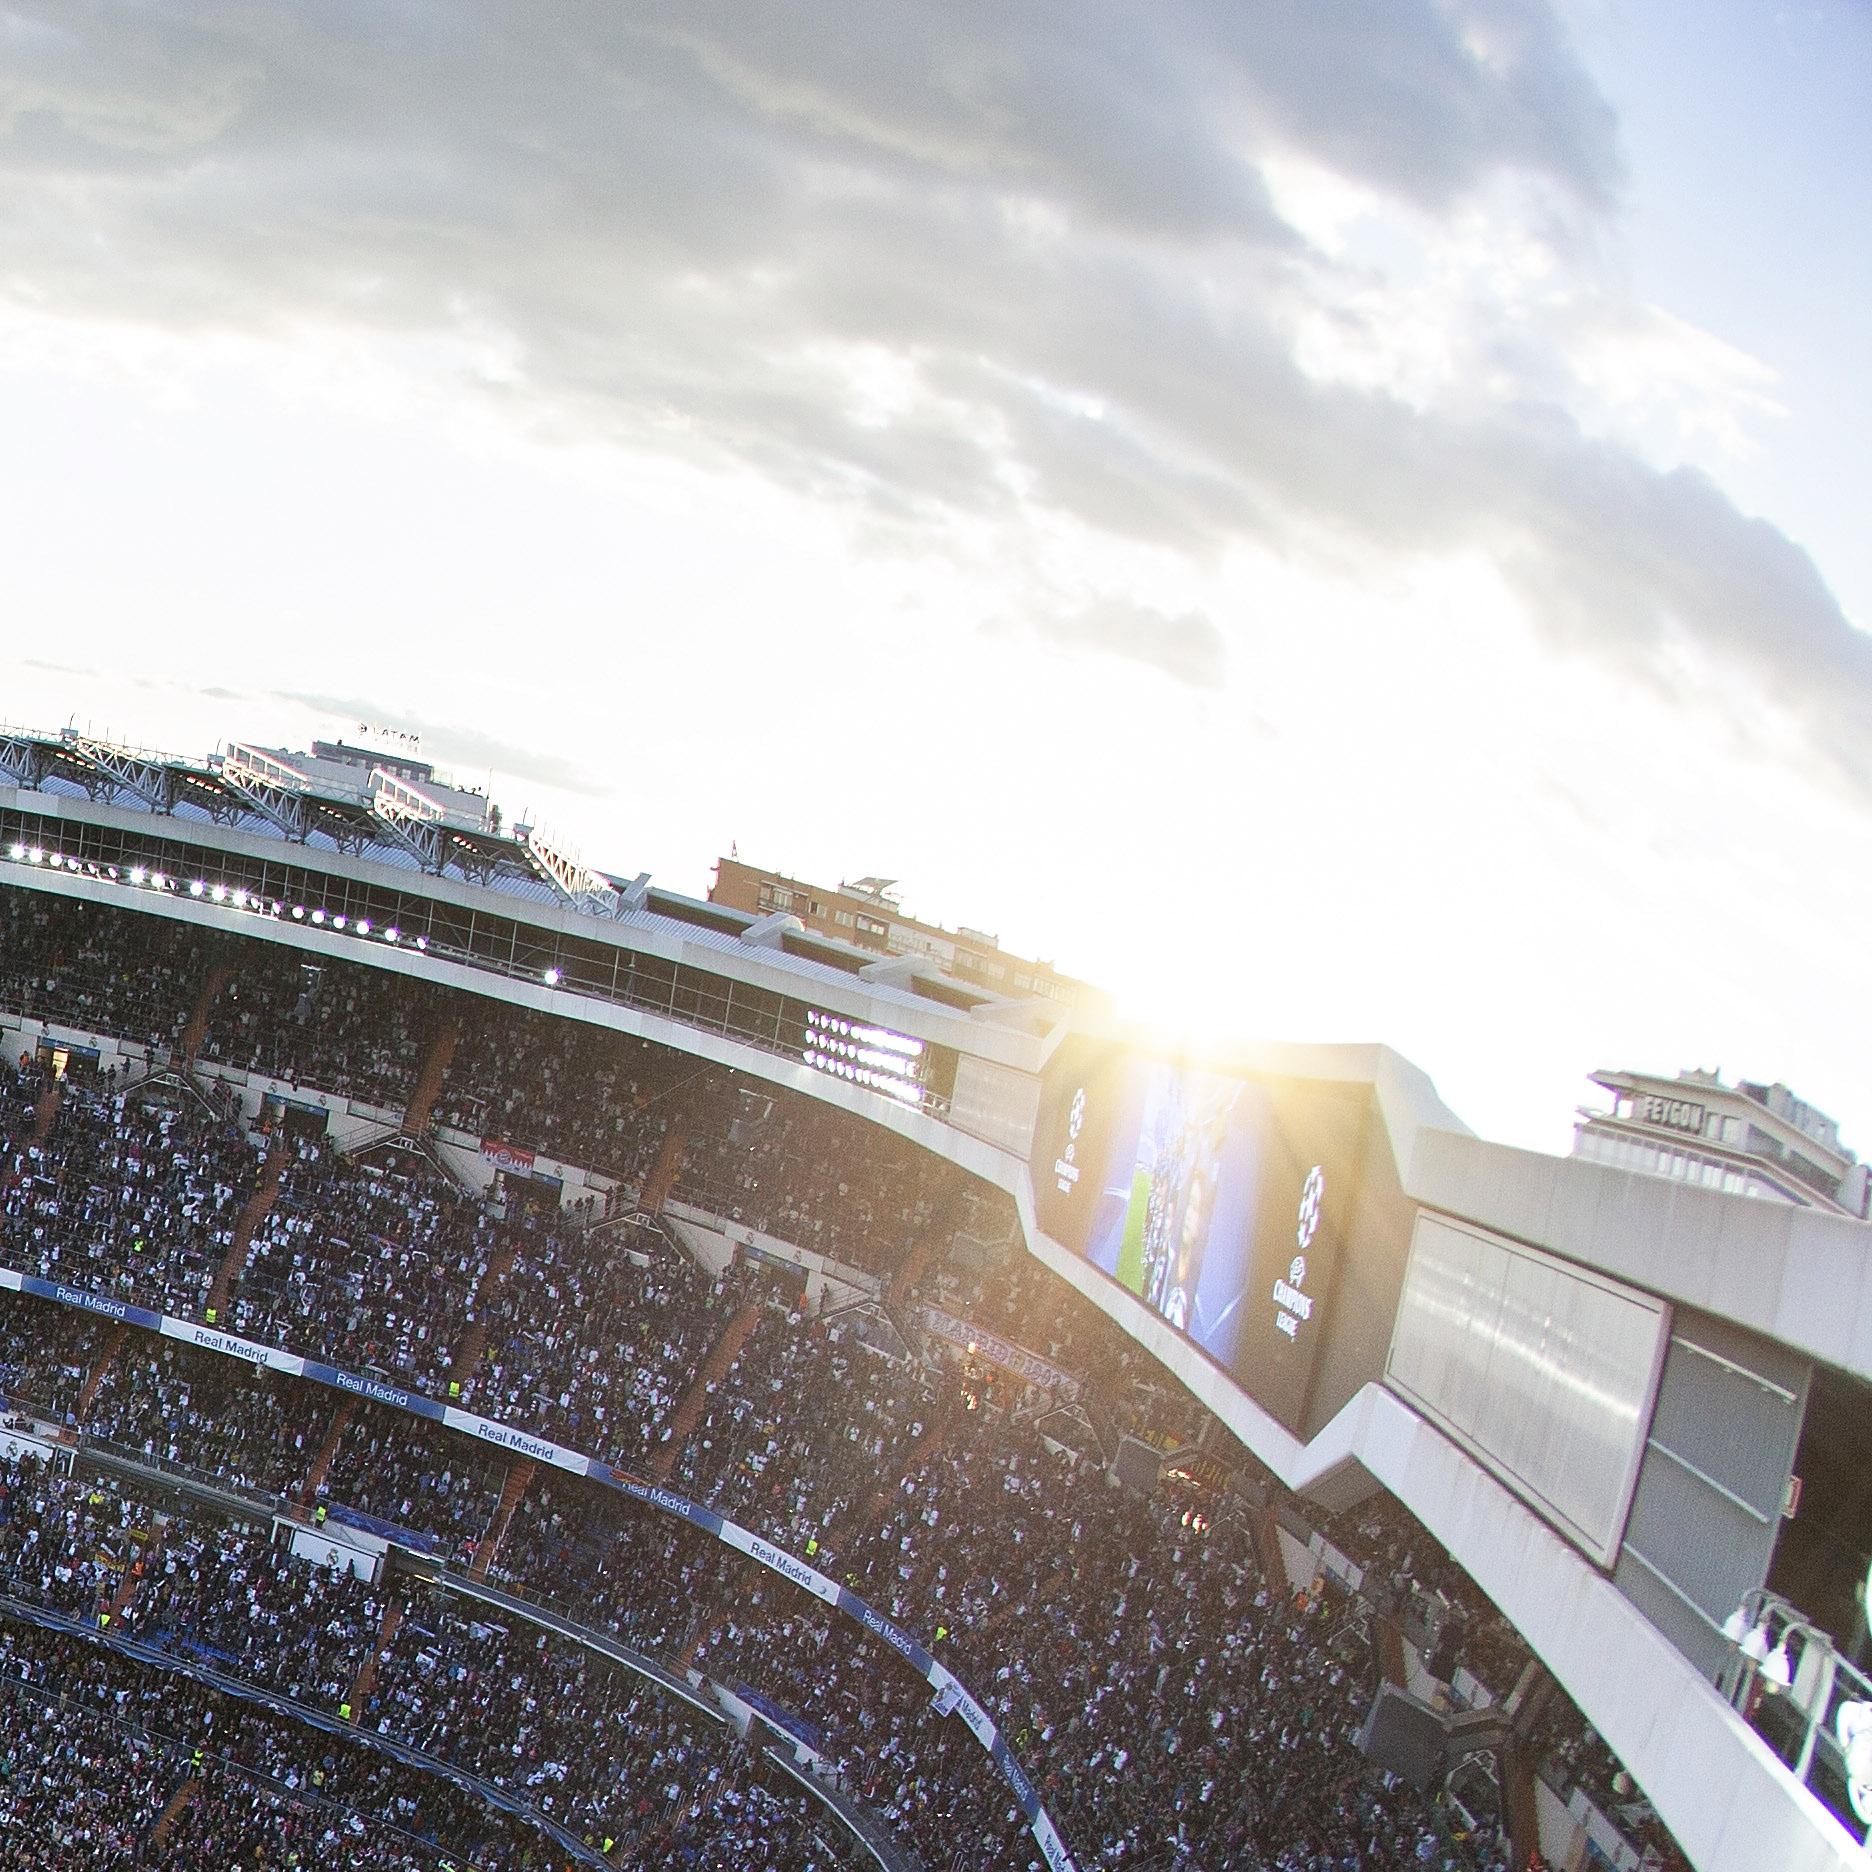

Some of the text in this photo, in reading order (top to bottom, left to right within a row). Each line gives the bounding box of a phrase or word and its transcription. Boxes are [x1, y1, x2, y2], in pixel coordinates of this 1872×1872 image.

[57, 1288, 126, 1318] Real Madrid
[195, 1331, 269, 1363] Real Madrid
[336, 1373, 409, 1406] Real Madrid
[478, 1424, 553, 1461] Real Madrid
[621, 1480, 692, 1516] Real Madrid
[750, 1542, 813, 1587] Real Madrid
[863, 1609, 913, 1656] Real Madrid
